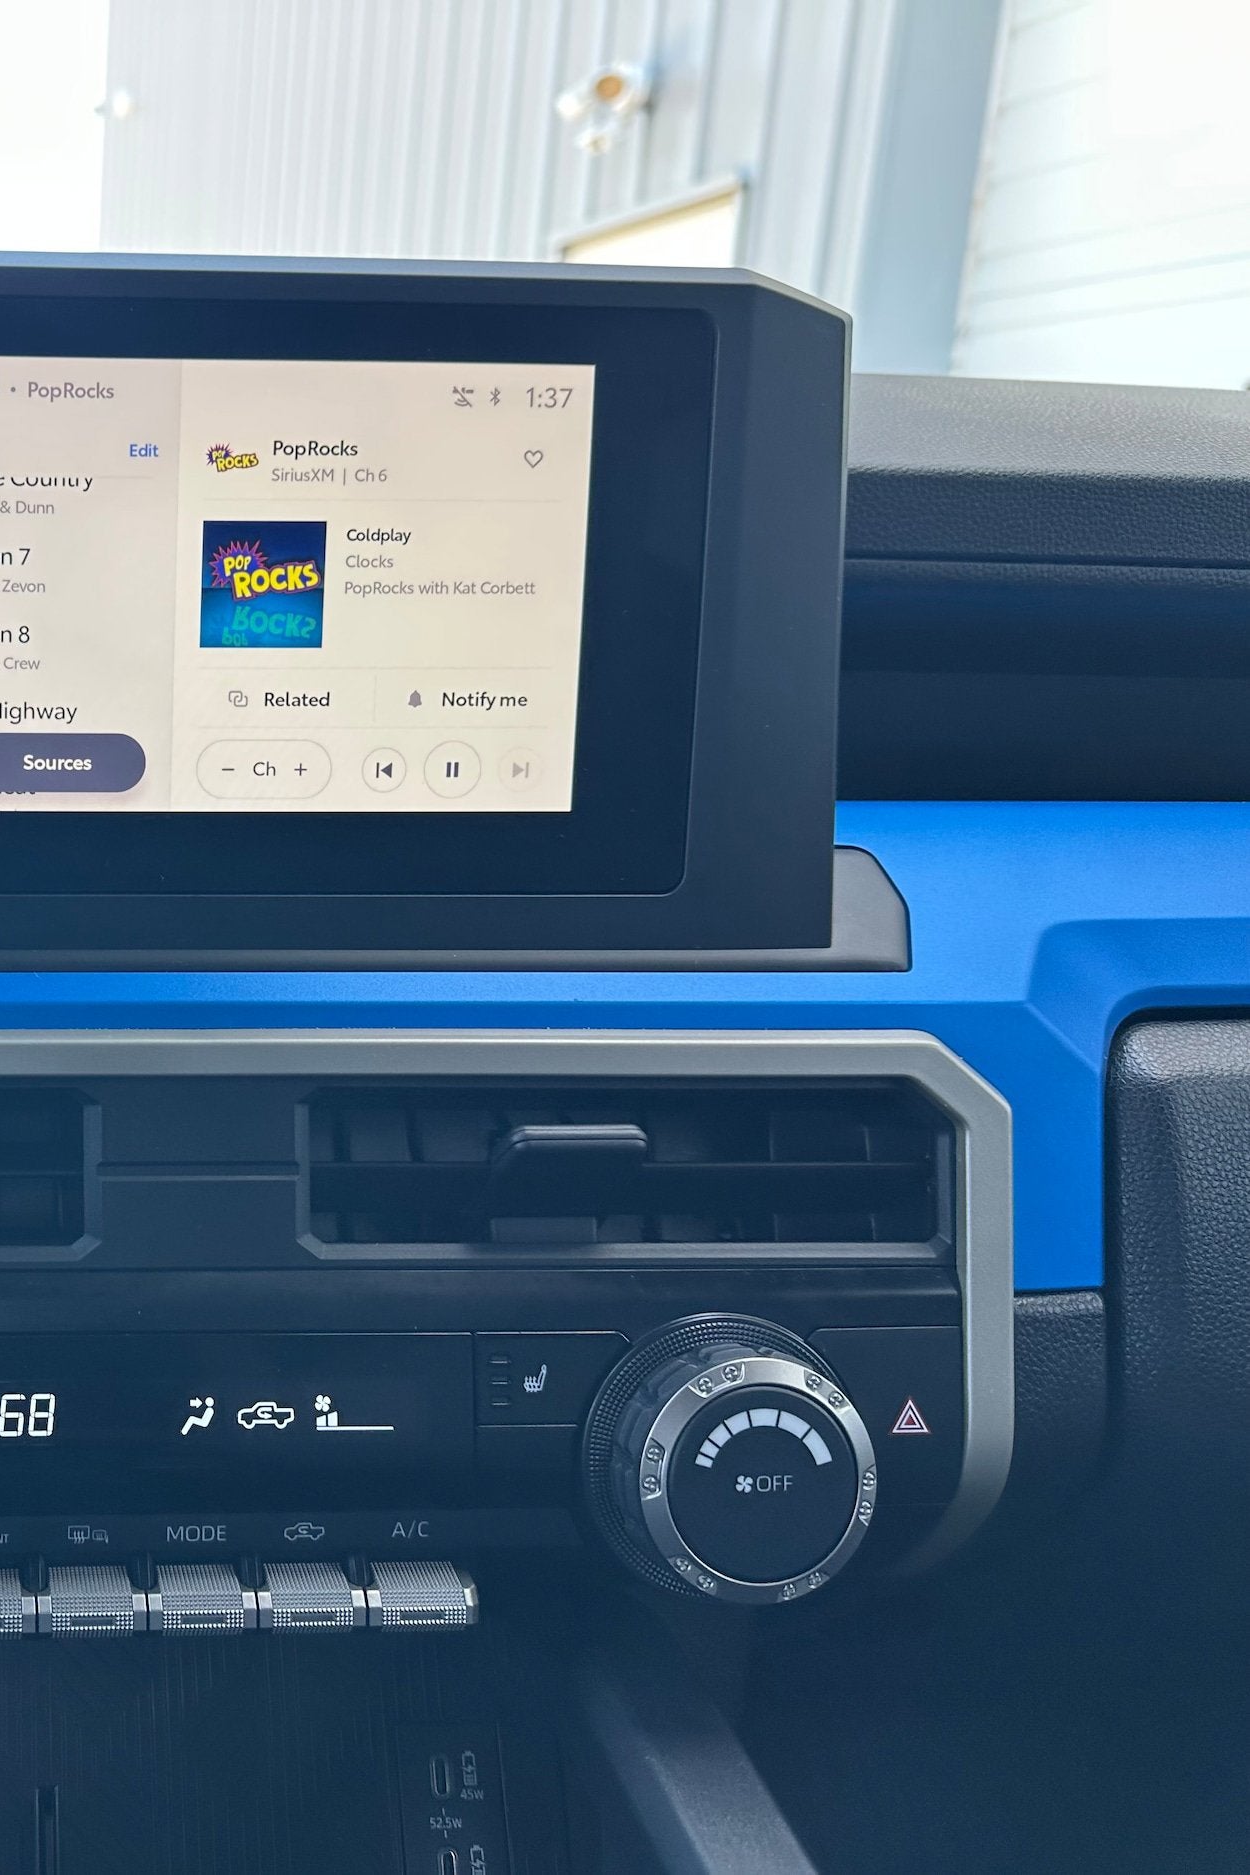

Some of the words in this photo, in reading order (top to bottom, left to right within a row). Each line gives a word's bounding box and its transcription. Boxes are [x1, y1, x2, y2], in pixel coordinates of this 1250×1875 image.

[28, 382, 114, 402] PopRocks
[527, 387, 573, 408] 1:37
[130, 444, 158, 457] Edit
[274, 440, 357, 460] PopRocks
[216, 453, 259, 472] ROCKS
[272, 468, 334, 482] SiriusXM
[355, 468, 374, 482] Ch
[379, 469, 387, 482] 6
[0, 501, 10, 513] &
[16, 501, 54, 514] Dunn
[347, 528, 411, 545] Coldplay
[19, 548, 30, 565] 7
[346, 555, 393, 568] Clocks
[224, 556, 252, 577] POP
[2, 580, 45, 592] Zevon
[234, 564, 320, 598] ROCKS
[345, 581, 414, 598] PopRocks
[418, 581, 448, 594] with
[454, 581, 476, 594] Kat
[481, 581, 535, 594] Corbett
[19, 626, 29, 643] 8
[4, 657, 40, 670] Crew
[265, 692, 330, 706] Related
[443, 692, 496, 710] Notify
[500, 697, 527, 706] me
[23, 754, 92, 770] Sources
[253, 762, 275, 776] Ch
[0, 1394, 55, 1437] 68
[757, 1475, 792, 1492] OFF
[166, 1525, 226, 1542] MODE
[392, 1520, 428, 1538] A/C
[460, 1789, 483, 1800] 45W
[429, 1817, 462, 1829] 52.5W
